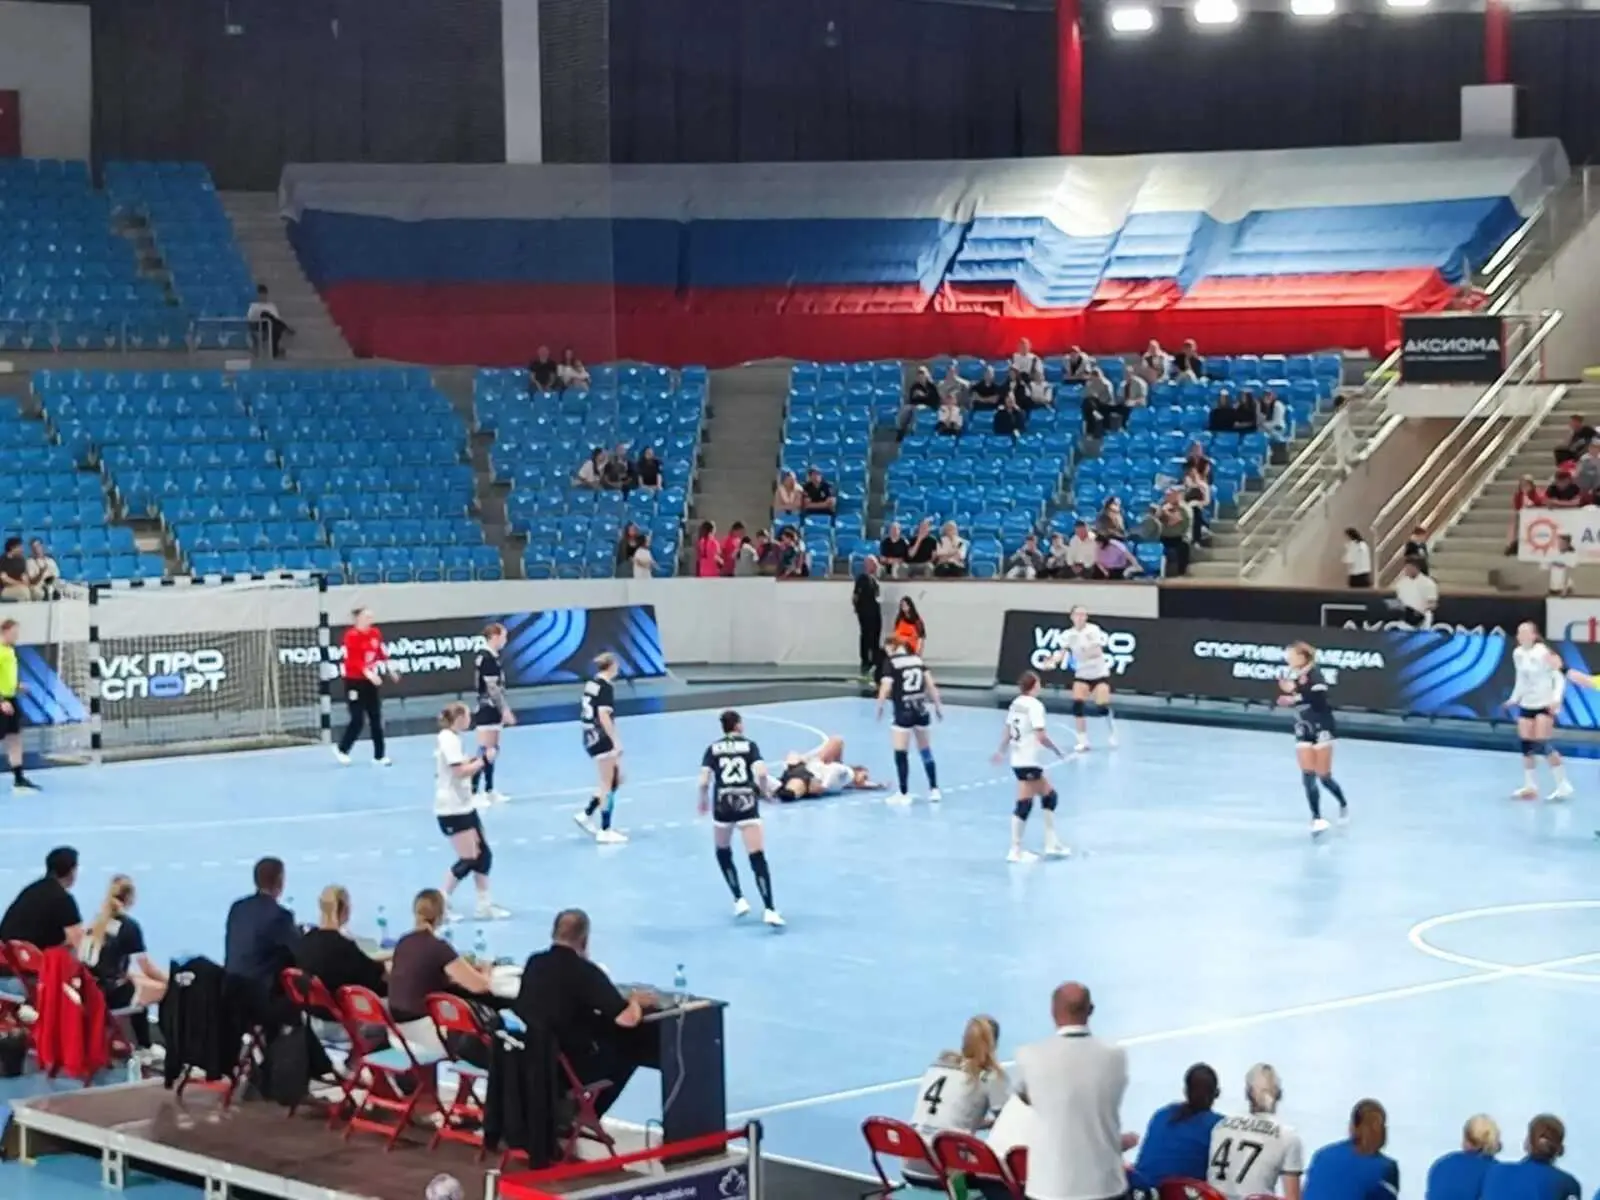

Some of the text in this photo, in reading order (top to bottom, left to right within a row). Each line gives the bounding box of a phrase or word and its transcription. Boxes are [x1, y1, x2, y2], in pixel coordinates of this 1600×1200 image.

[1405, 337, 1501, 352] АКСИОМА
[98, 649, 224, 679] VK ПРО
[101, 671, 227, 701] СПОРТ
[902, 668, 923, 692] 27
[718, 755, 748, 785] 23
[923, 1075, 948, 1115] 4
[1210, 1137, 1265, 1185] 47
